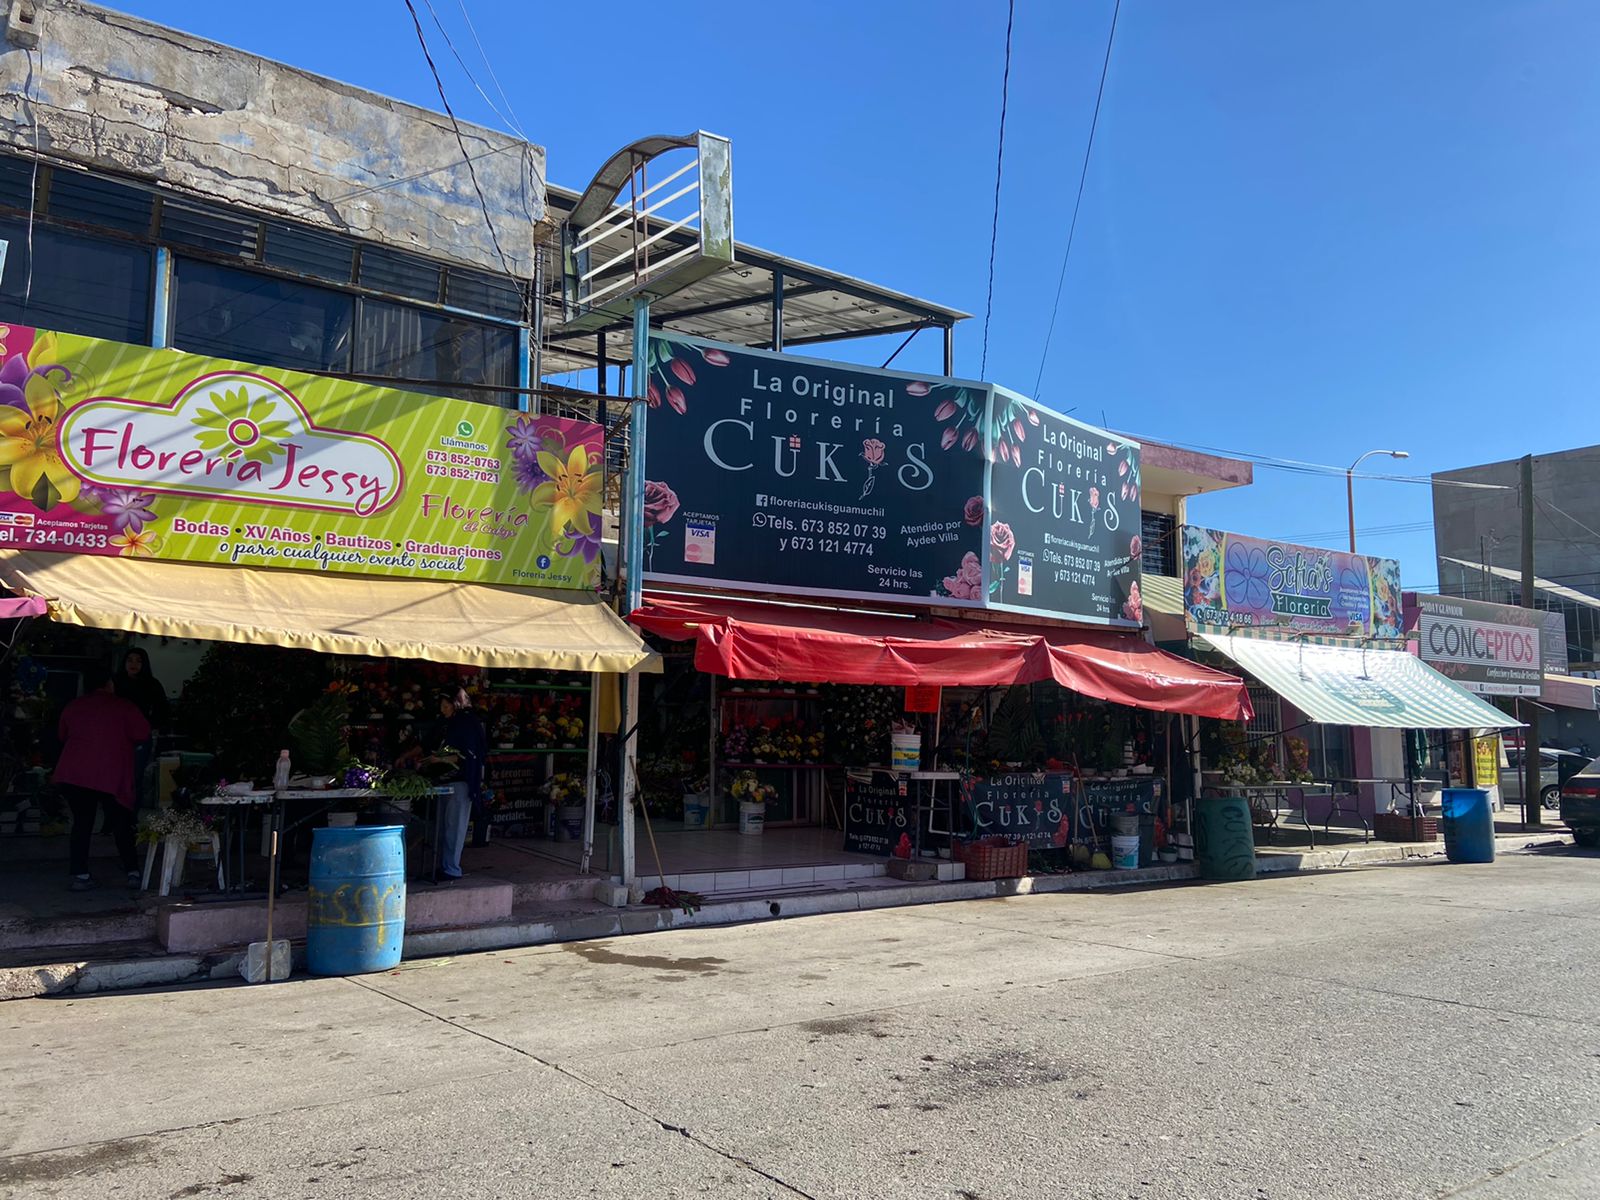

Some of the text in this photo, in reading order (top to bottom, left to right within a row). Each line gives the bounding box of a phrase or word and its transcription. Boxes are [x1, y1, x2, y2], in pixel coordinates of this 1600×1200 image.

[753, 368, 895, 409] La Original
[740, 397, 904, 438] Florería
[440, 436, 489, 452] Llámanos:
[1043, 424, 1103, 463] La Original
[80, 422, 387, 518] Florería Jessy
[426, 450, 501, 472] 673 852-0763
[426, 465, 501, 487] 673 852-7021
[421, 492, 530, 527] Florería
[683, 511, 720, 521] ACEPTAMOS
[37, 518, 109, 532] Aceptamos Tarjetas
[691, 529, 711, 539] VISA
[767, 514, 888, 541] Tels. 673 852 07 39
[900, 518, 962, 536] Atendido por
[0, 528, 108, 550] el. 734-0433
[172, 517, 503, 563] Bodas XV Años Bautizos Graduaciones
[779, 536, 875, 557] y 673 121 4774
[906, 531, 960, 549] Aydee Villa
[219, 539, 466, 574] o para cualquier evento social
[1049, 551, 1063, 566] Tels.
[1064, 554, 1075, 569] 673
[1075, 556, 1086, 571] 852
[1086, 559, 1093, 571] 07
[1093, 559, 1101, 573] 39
[547, 572, 573, 584] Jessy
[867, 563, 924, 580] Servicio las
[1059, 569, 1070, 584] 673
[1071, 571, 1081, 584] 121
[1081, 573, 1096, 587] 4774
[879, 577, 912, 591] 24 hrs.
[1428, 622, 1534, 665] CONCEPTOS
